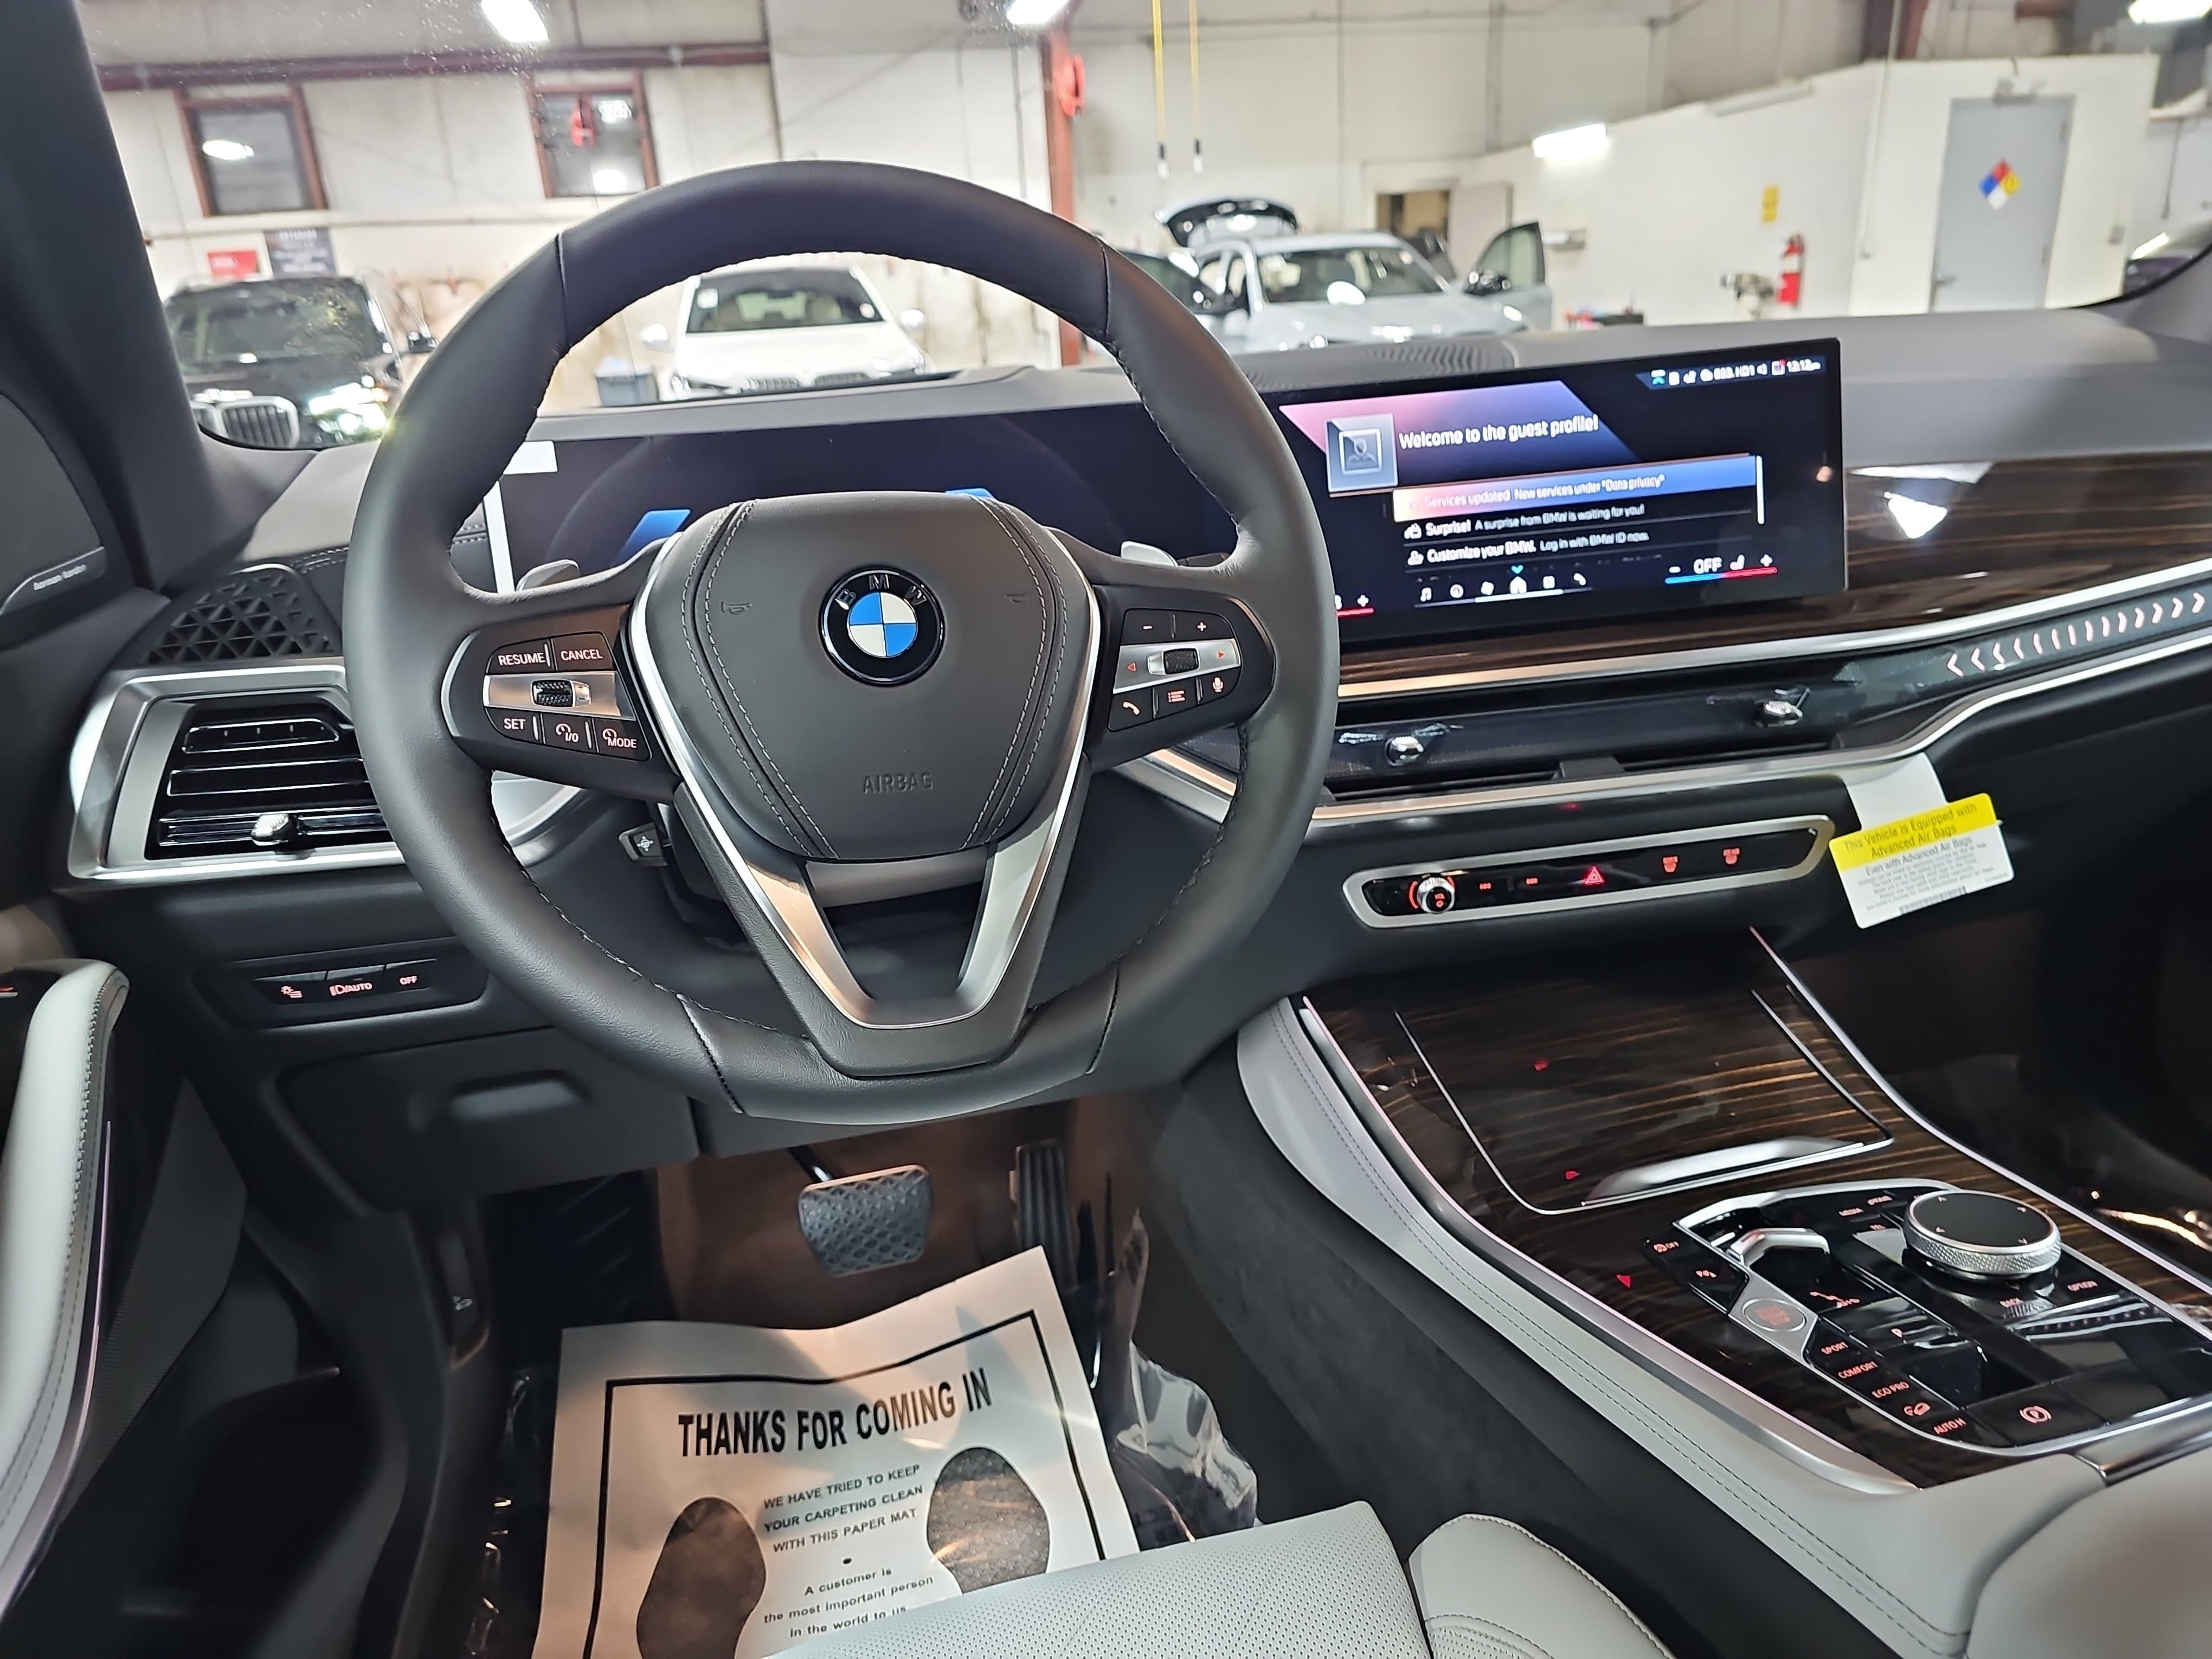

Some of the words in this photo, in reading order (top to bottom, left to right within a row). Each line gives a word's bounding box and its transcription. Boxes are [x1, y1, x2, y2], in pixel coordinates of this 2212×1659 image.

[1399, 429, 1463, 449] Welcome
[1465, 427, 1481, 443] to
[1482, 424, 1506, 442] the
[1508, 420, 1548, 442] guest
[1551, 414, 1599, 438] profile!
[1425, 495, 1467, 508] Services
[1468, 489, 1510, 505] updated
[1514, 488, 1535, 500] New
[1536, 485, 1573, 498] services
[1574, 481, 1600, 495] under
[1425, 519, 1471, 536] Surprise!
[1475, 519, 1483, 531] A
[1484, 517, 1519, 530] surprise
[1520, 515, 1542, 526] from
[1542, 511, 1568, 524] BMW
[1568, 511, 1577, 522] is
[1577, 508, 1611, 520] waiting
[1611, 506, 1624, 517] for
[1427, 546, 1480, 563] Customize
[1481, 545, 1504, 559] your
[1540, 540, 1559, 552] Log
[1559, 538, 1568, 549] in
[1569, 537, 1589, 548] with
[1589, 533, 1614, 546] BMW
[1615, 532, 1626, 544] ID
[1694, 557, 1722, 573] OFF
[498, 652, 546, 666] RESUME
[560, 648, 603, 661] CANCEL
[503, 718, 526, 730] SET
[607, 737, 637, 748] MODE
[863, 772, 933, 794] AIRBAG
[1844, 840, 1863, 852] This
[1864, 827, 1898, 844] Vehicle
[1900, 824, 1909, 834] is
[1909, 809, 1954, 832] Equipped
[1957, 802, 1977, 817] with
[1871, 839, 1914, 858] Advanced
[1917, 831, 1931, 844] Air
[1933, 824, 1957, 840] Bags
[1865, 863, 1883, 876] Even
[1885, 858, 1901, 871] with
[1901, 846, 1939, 864] Advanced
[1940, 841, 1951, 852] Air
[1952, 835, 1972, 851] Bags
[399, 975, 417, 985] OFF
[1821, 1341, 1848, 1355] SPORT
[1838, 1361, 1878, 1379] COMFORT
[1872, 1386, 1891, 1398] ECO
[1889, 1381, 1909, 1393] PRO
[678, 1410, 786, 1457] THANKS
[798, 1411, 847, 1451] FOR
[857, 1381, 956, 1439] COMING
[962, 1368, 992, 1412] IN
[1933, 1419, 1957, 1434] AUTO
[1956, 1417, 1966, 1426] H
[764, 1496, 783, 1509] WE
[788, 1487, 822, 1504] HAVE
[826, 1478, 862, 1495] TRIED
[867, 1473, 883, 1486] TO
[888, 1464, 920, 1481] KEEP
[764, 1516, 800, 1533] YOUR
[805, 1497, 877, 1522] CARPETING
[882, 1484, 923, 1504] CLEAN
[773, 1536, 806, 1553] WITH
[810, 1529, 839, 1545] THIS
[843, 1516, 885, 1536] PAPER
[891, 1508, 917, 1523] MAT
[804, 1586, 814, 1596] A
[819, 1572, 877, 1593] customer
[882, 1567, 892, 1576] is
[764, 1612, 783, 1623] the
[788, 1605, 820, 1619] most
[826, 1588, 886, 1612] important
[891, 1576, 934, 1597] person
[790, 1628, 802, 1637] in
[807, 1621, 827, 1634] the
[833, 1613, 869, 1630] world
[874, 1611, 886, 1620] to
